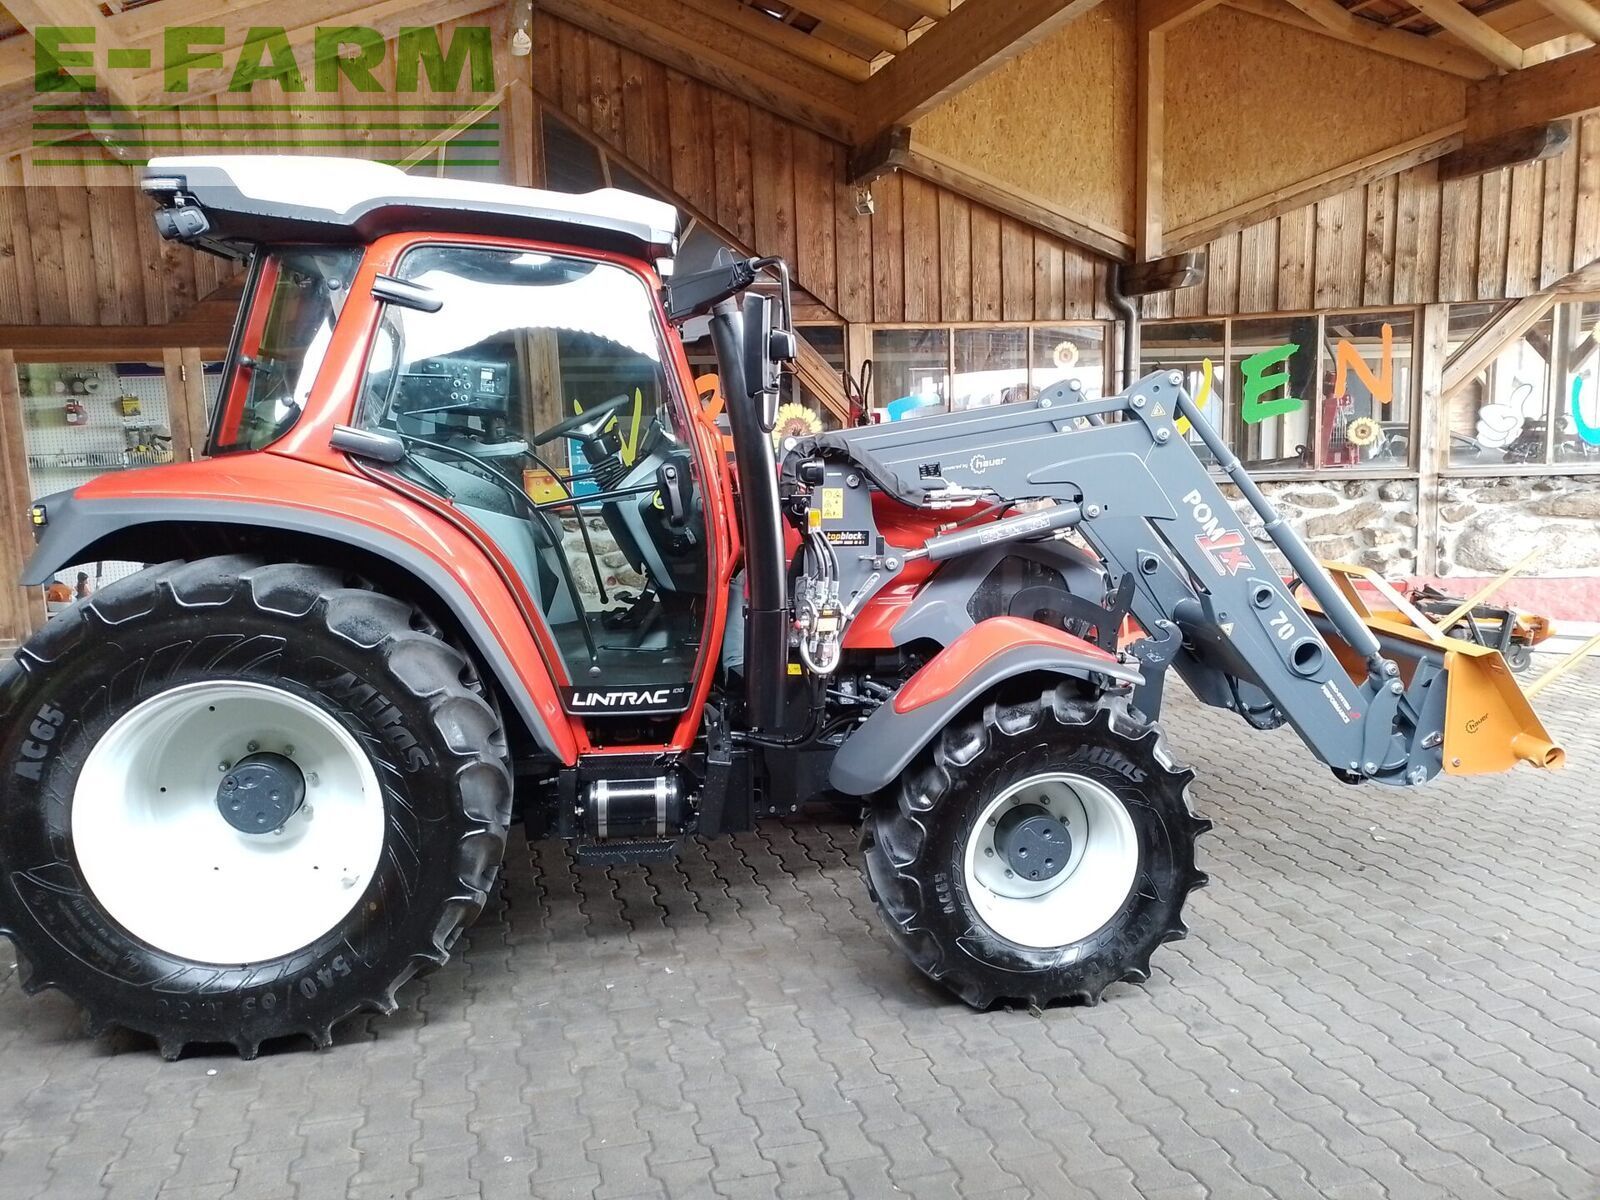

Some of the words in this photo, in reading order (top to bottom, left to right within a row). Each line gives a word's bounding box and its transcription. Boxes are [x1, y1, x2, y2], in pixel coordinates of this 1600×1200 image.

[826, 530, 863, 541] topblock
[1182, 488, 1226, 542] POM
[1270, 609, 1296, 640] 70
[571, 689, 670, 706] LINTRAC
[14, 703, 65, 781] AC65
[317, 672, 431, 773] Mitas
[1073, 743, 1148, 783] Mitas
[933, 872, 956, 914] AC65
